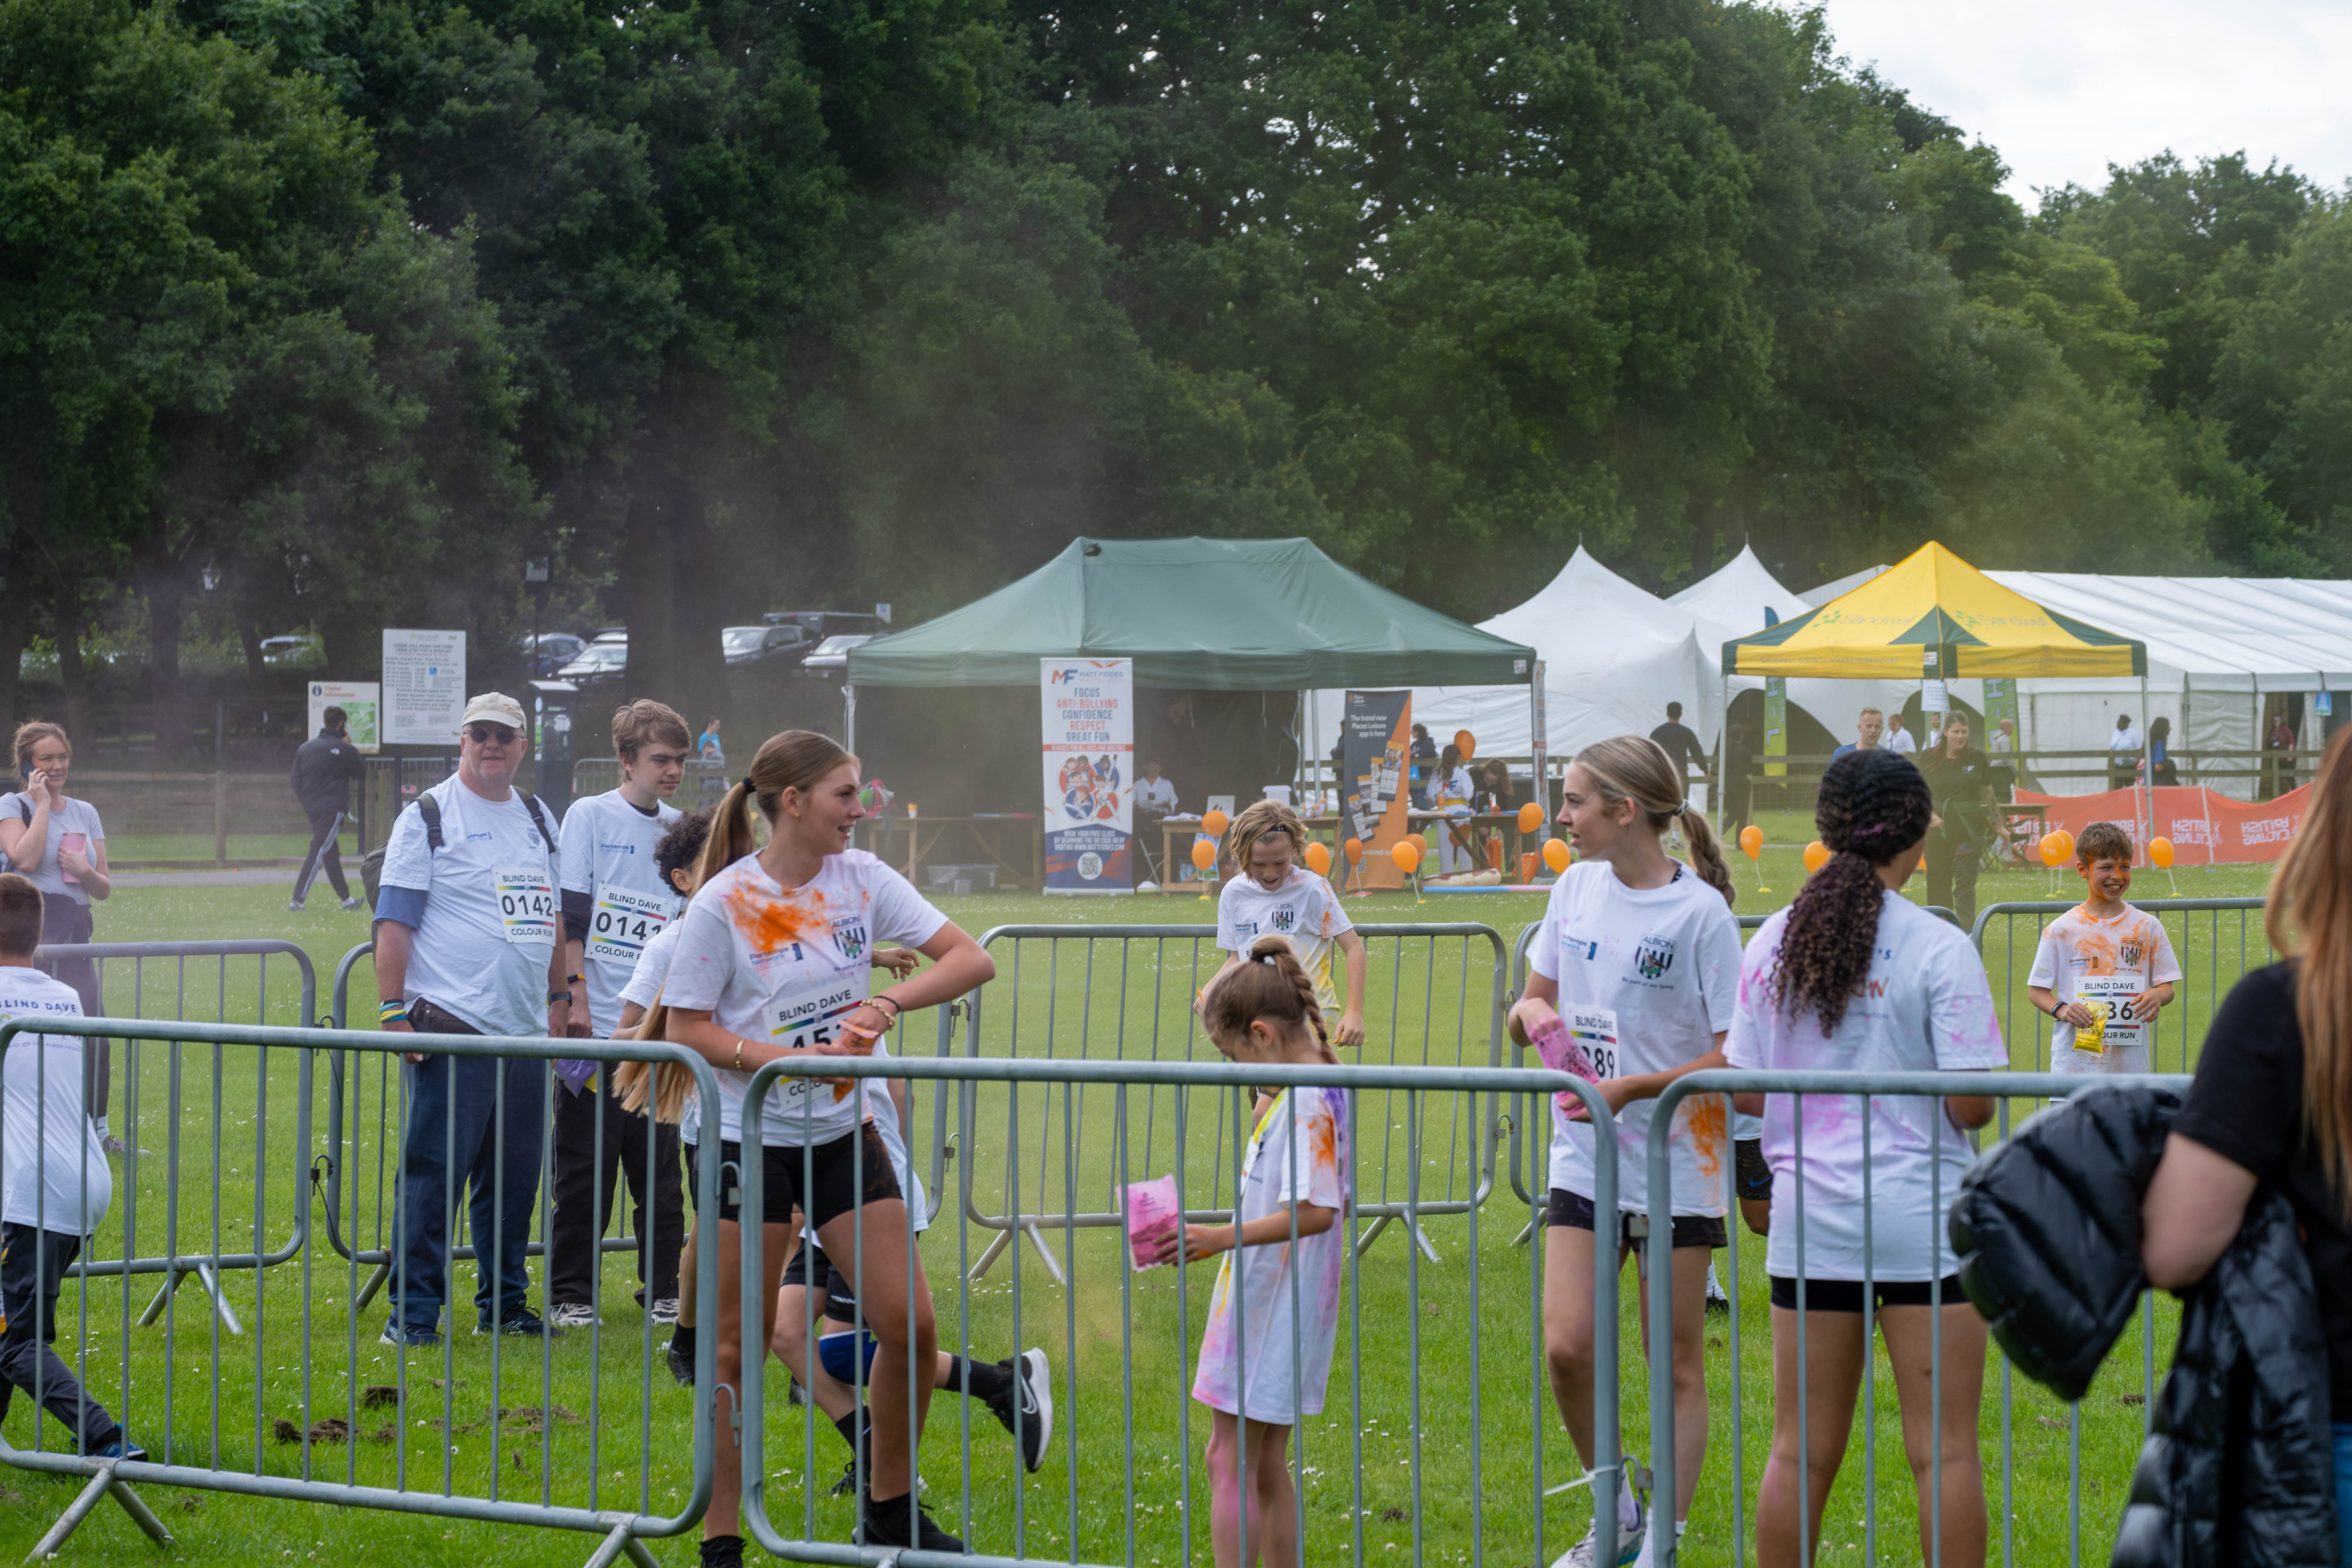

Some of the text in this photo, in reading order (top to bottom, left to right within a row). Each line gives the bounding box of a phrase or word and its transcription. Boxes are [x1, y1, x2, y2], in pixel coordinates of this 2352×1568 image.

[1052, 670, 1078, 684] MF
[1074, 688, 1100, 697] FOCUS
[1057, 698, 1118, 709] ANTI-BULLYING
[1062, 710, 1113, 720] CONFIDENCE
[1070, 721, 1106, 730] RESPECT
[1066, 732, 1110, 742] GREAT FUN
[1442, 780, 1458, 791] MF
[502, 895, 553, 917] 0142
[609, 893, 662, 911] BLIND DAVE
[832, 916, 860, 927] ALBION
[1643, 936, 1674, 949] ALBION
[595, 945, 634, 959] COLOUR
[0, 1000, 77, 1012] LIND DAVE
[779, 989, 852, 1022] BLIND DAVE
[2104, 1001, 2133, 1020] 36
[1576, 1015, 1613, 1032] BLIND DAVE
[1582, 1046, 1615, 1079] 89
